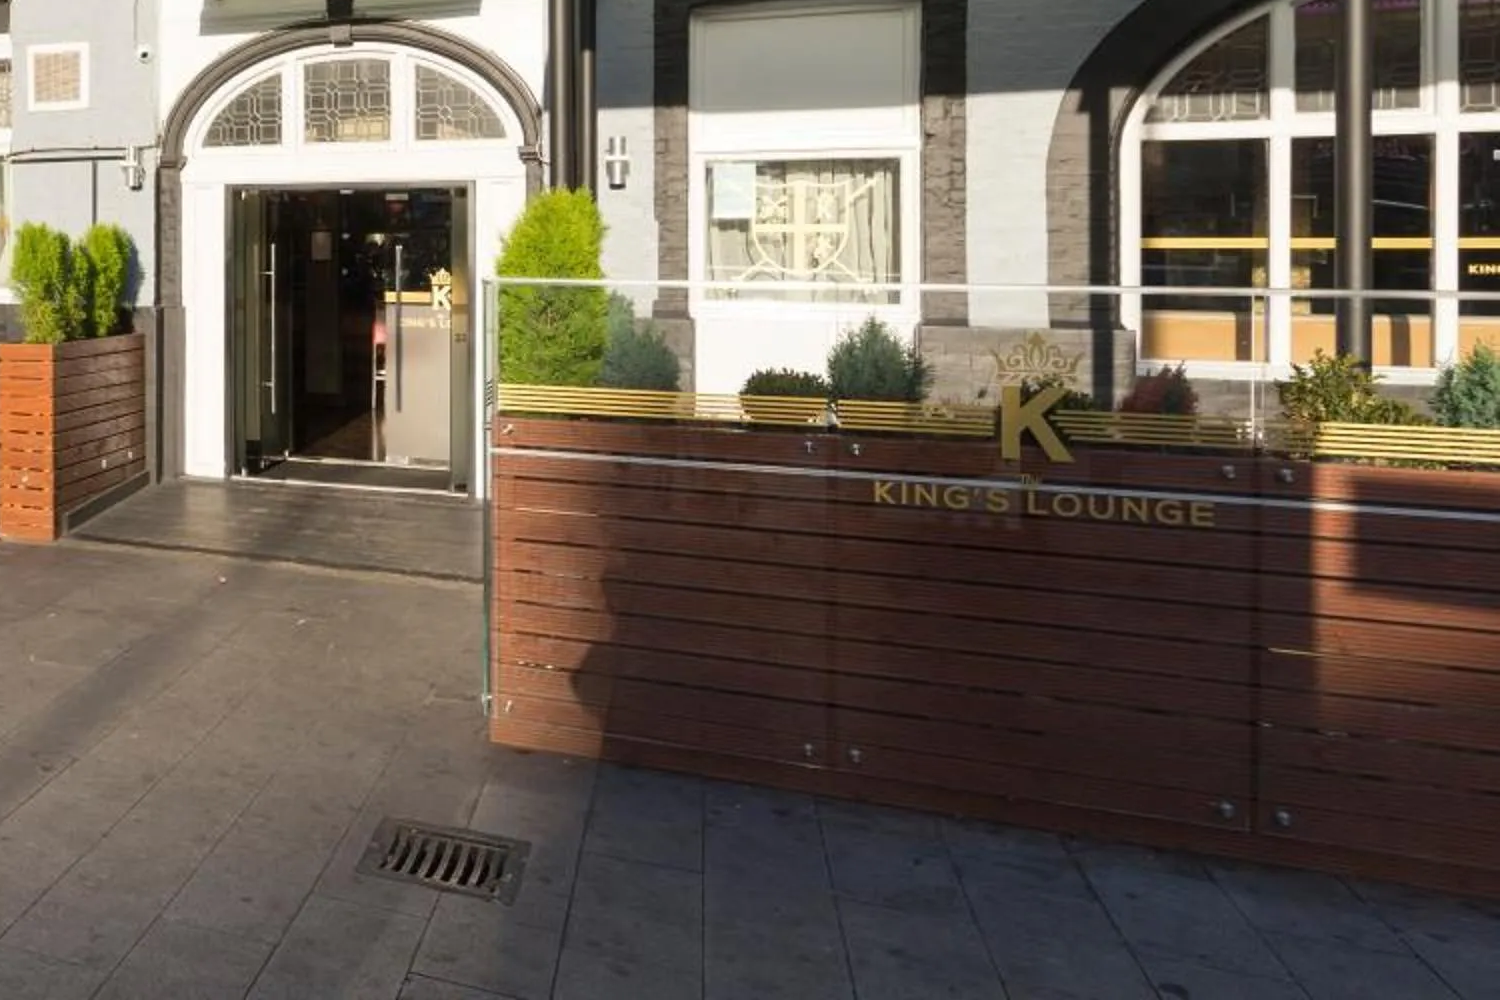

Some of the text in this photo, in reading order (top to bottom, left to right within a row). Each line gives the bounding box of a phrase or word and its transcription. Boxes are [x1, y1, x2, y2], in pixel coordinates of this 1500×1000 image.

[1467, 264, 1500, 275] KIN
[1001, 385, 1075, 462] K
[873, 480, 1216, 528] KING'S LOUNGE
